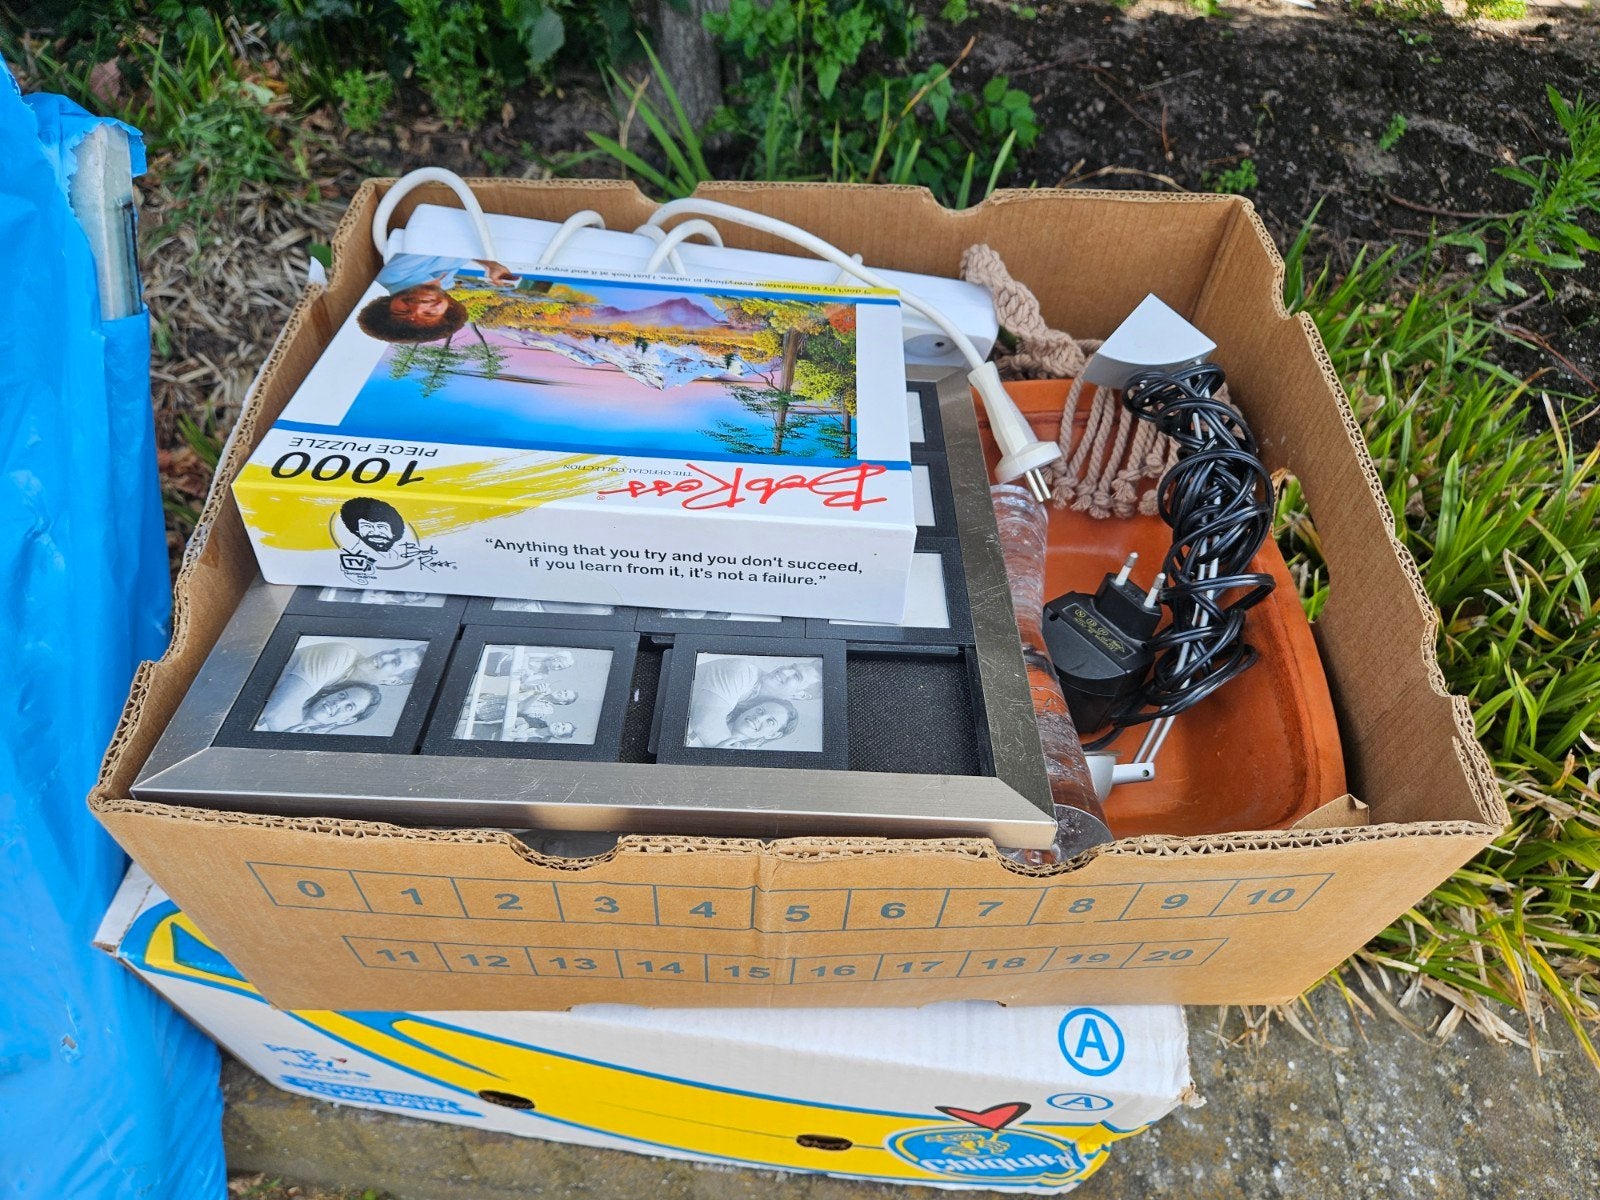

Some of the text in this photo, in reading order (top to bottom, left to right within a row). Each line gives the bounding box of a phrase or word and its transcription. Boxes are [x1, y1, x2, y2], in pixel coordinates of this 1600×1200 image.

[703, 277, 754, 287] everything
[755, 282, 810, 291] understand
[288, 437, 438, 458] PIECE PUZZLE
[270, 451, 425, 487] 1000
[562, 464, 693, 478] THE OFFICIAL COLLECTION
[745, 462, 888, 511] Bob
[399, 541, 438, 558] Bob
[573, 544, 606, 556] that
[610, 549, 640, 560] you
[644, 549, 667, 562] try
[672, 552, 702, 563] and
[707, 554, 737, 566] you
[742, 555, 783, 567] don't
[787, 559, 863, 574] succeed,
[345, 558, 364, 566] TV
[529, 557, 539, 567] if
[545, 560, 575, 571] you
[580, 560, 622, 573] learn
[626, 563, 664, 575] from
[669, 566, 684, 578] it,
[689, 567, 713, 579] it's
[717, 570, 744, 581] not
[748, 574, 758, 582] a
[296, 878, 1297, 923] 0 1 2 3 4 5 6 7 8 9 10
[376, 947, 1195, 980] 11 12 13 14 15 16 17 18 19 20
[1074, 1018, 1111, 1062] A
[1062, 1096, 1093, 1109] A
